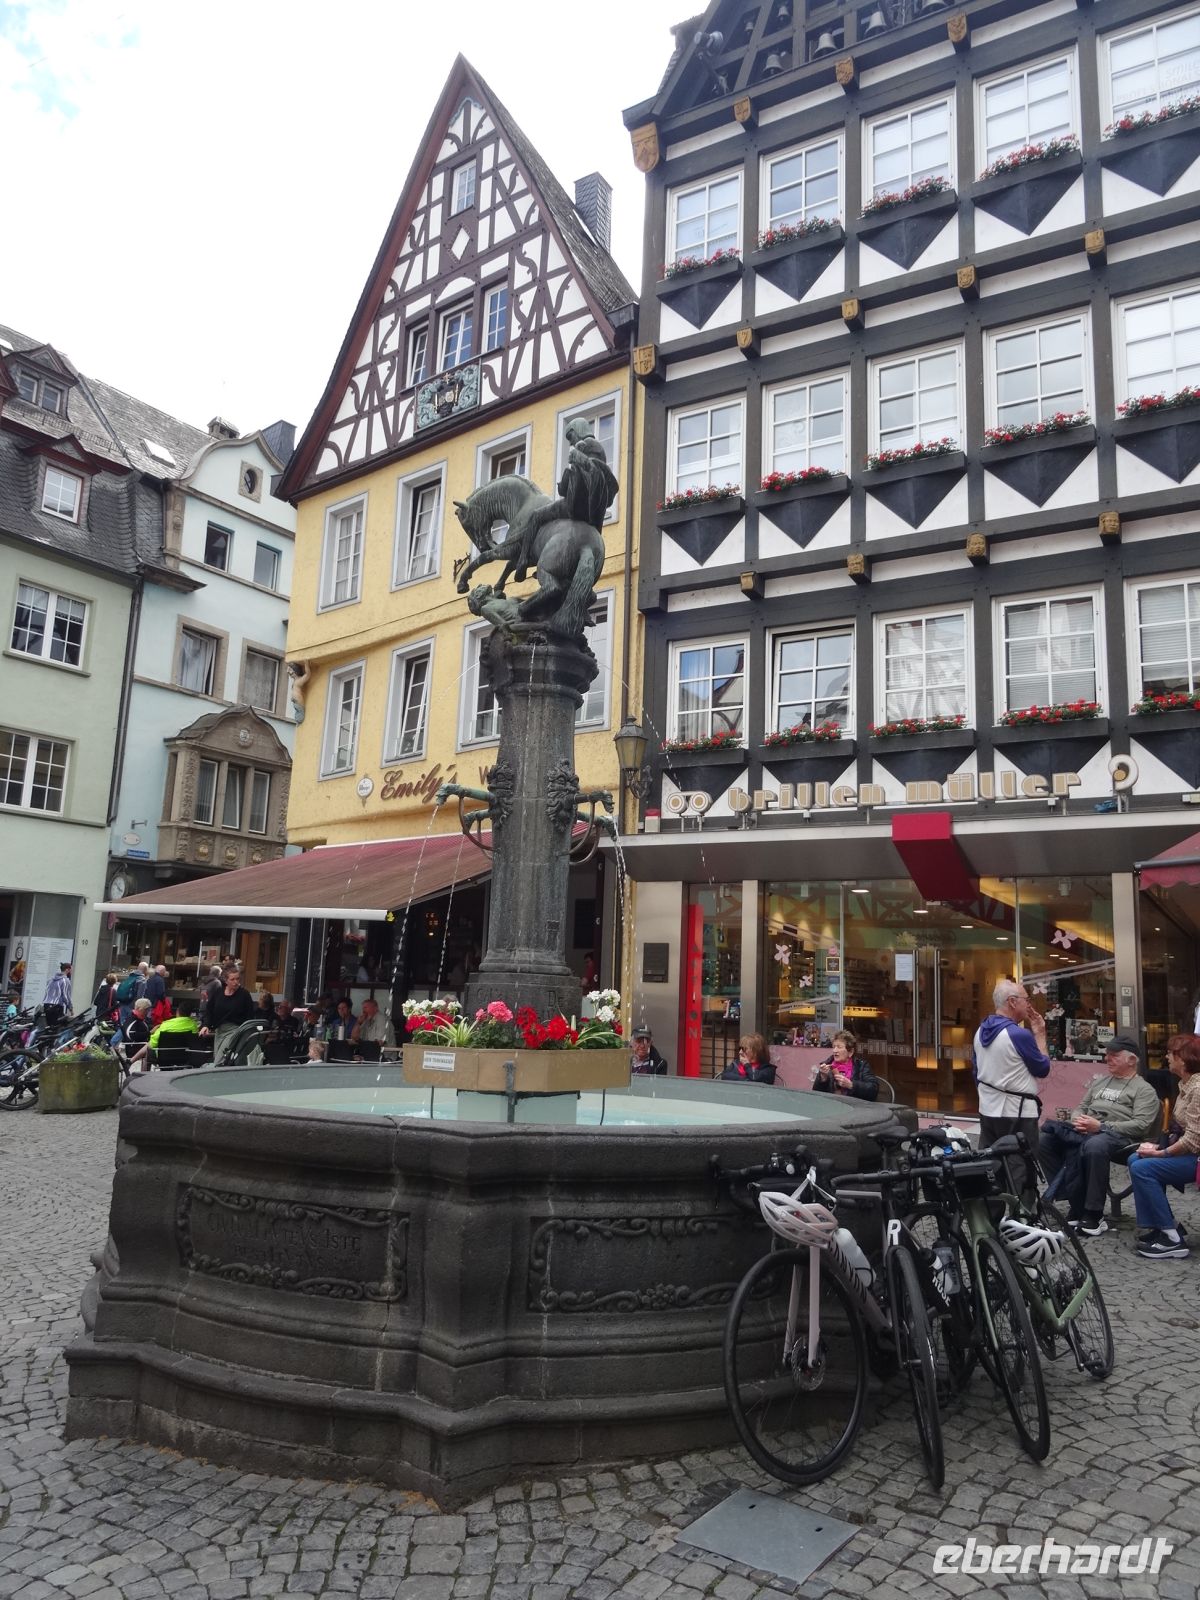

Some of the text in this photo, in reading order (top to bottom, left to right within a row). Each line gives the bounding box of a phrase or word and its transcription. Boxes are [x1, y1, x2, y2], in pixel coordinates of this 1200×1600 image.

[727, 770, 1081, 812] brillen müller
[856, 1039, 912, 1056] rillen
